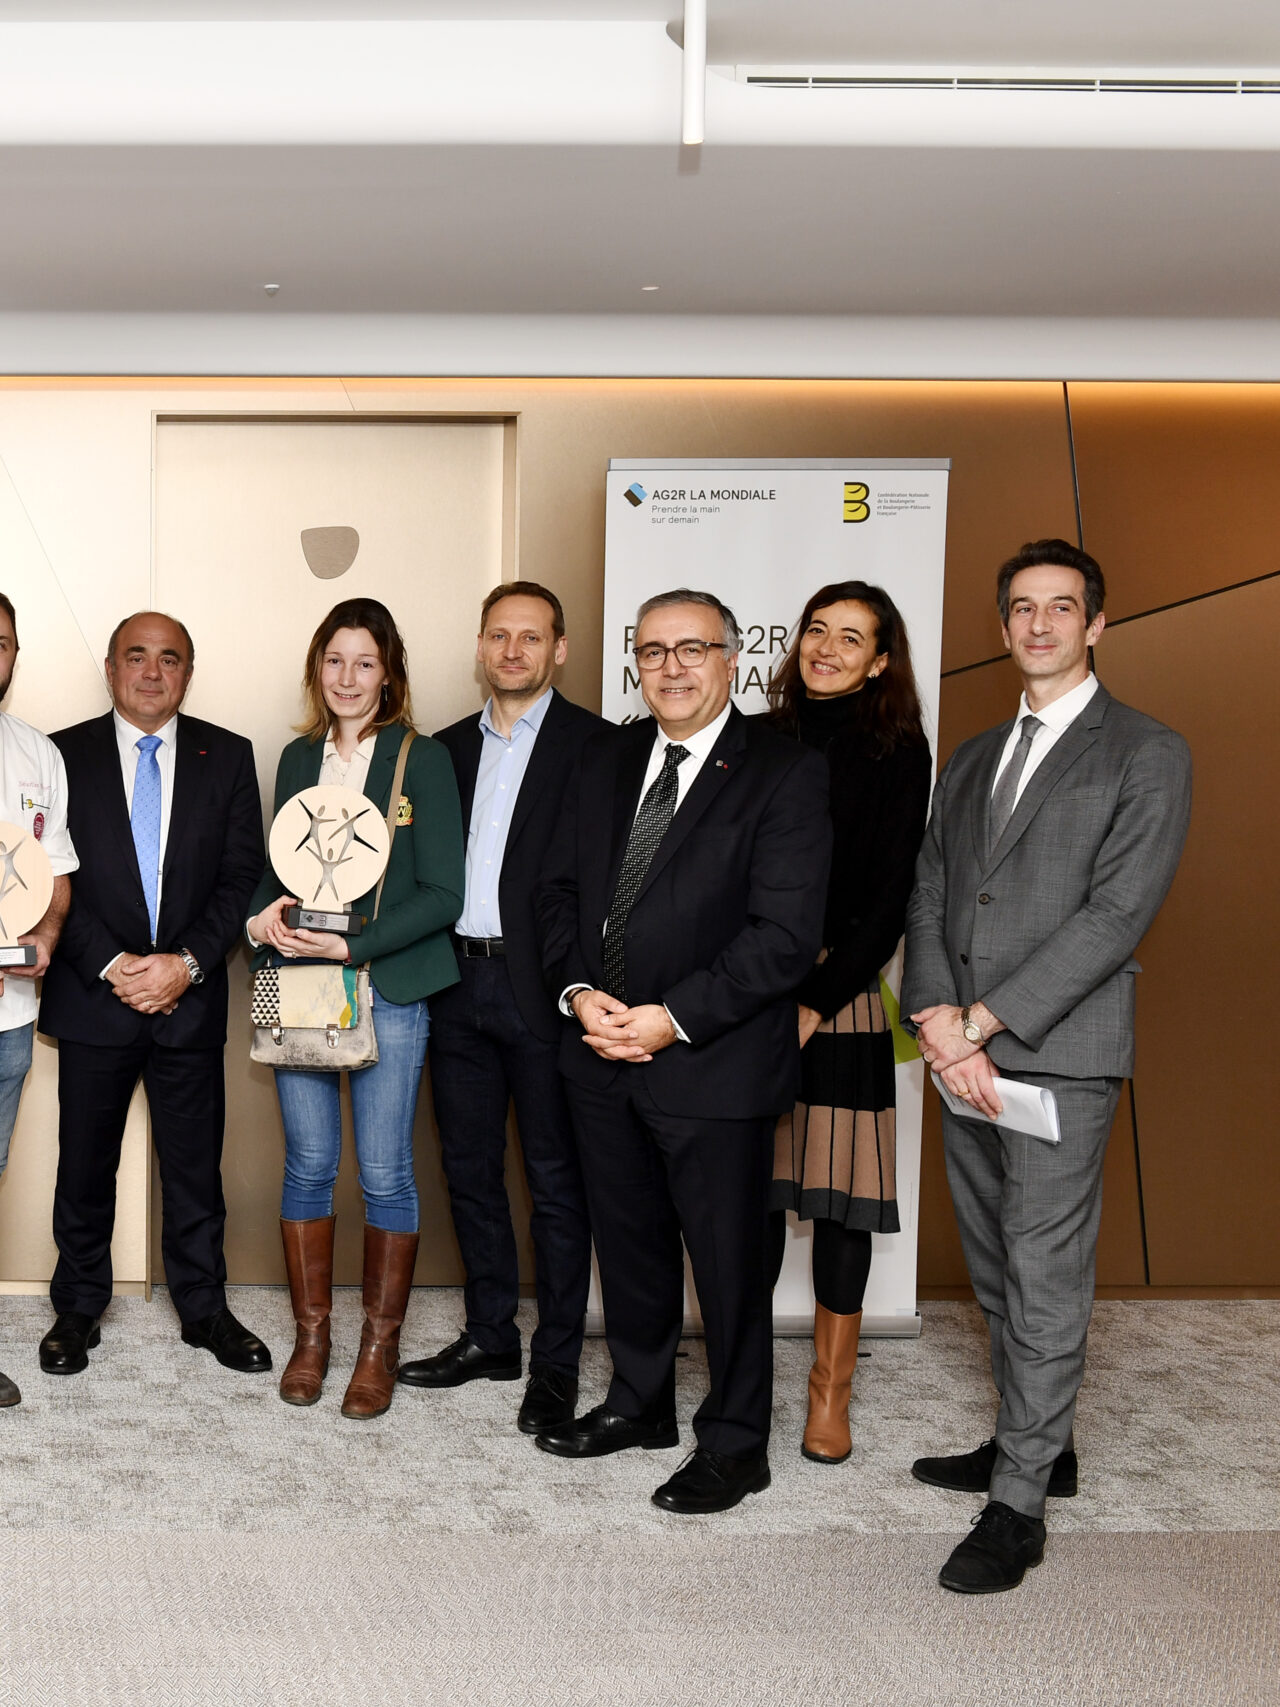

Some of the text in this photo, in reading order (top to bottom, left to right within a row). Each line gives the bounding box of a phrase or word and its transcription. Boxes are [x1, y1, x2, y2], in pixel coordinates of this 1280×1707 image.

[652, 489, 776, 500] AG2R LA MONDIALE
[651, 505, 720, 513] Prendre la main
[668, 516, 699, 524] demain
